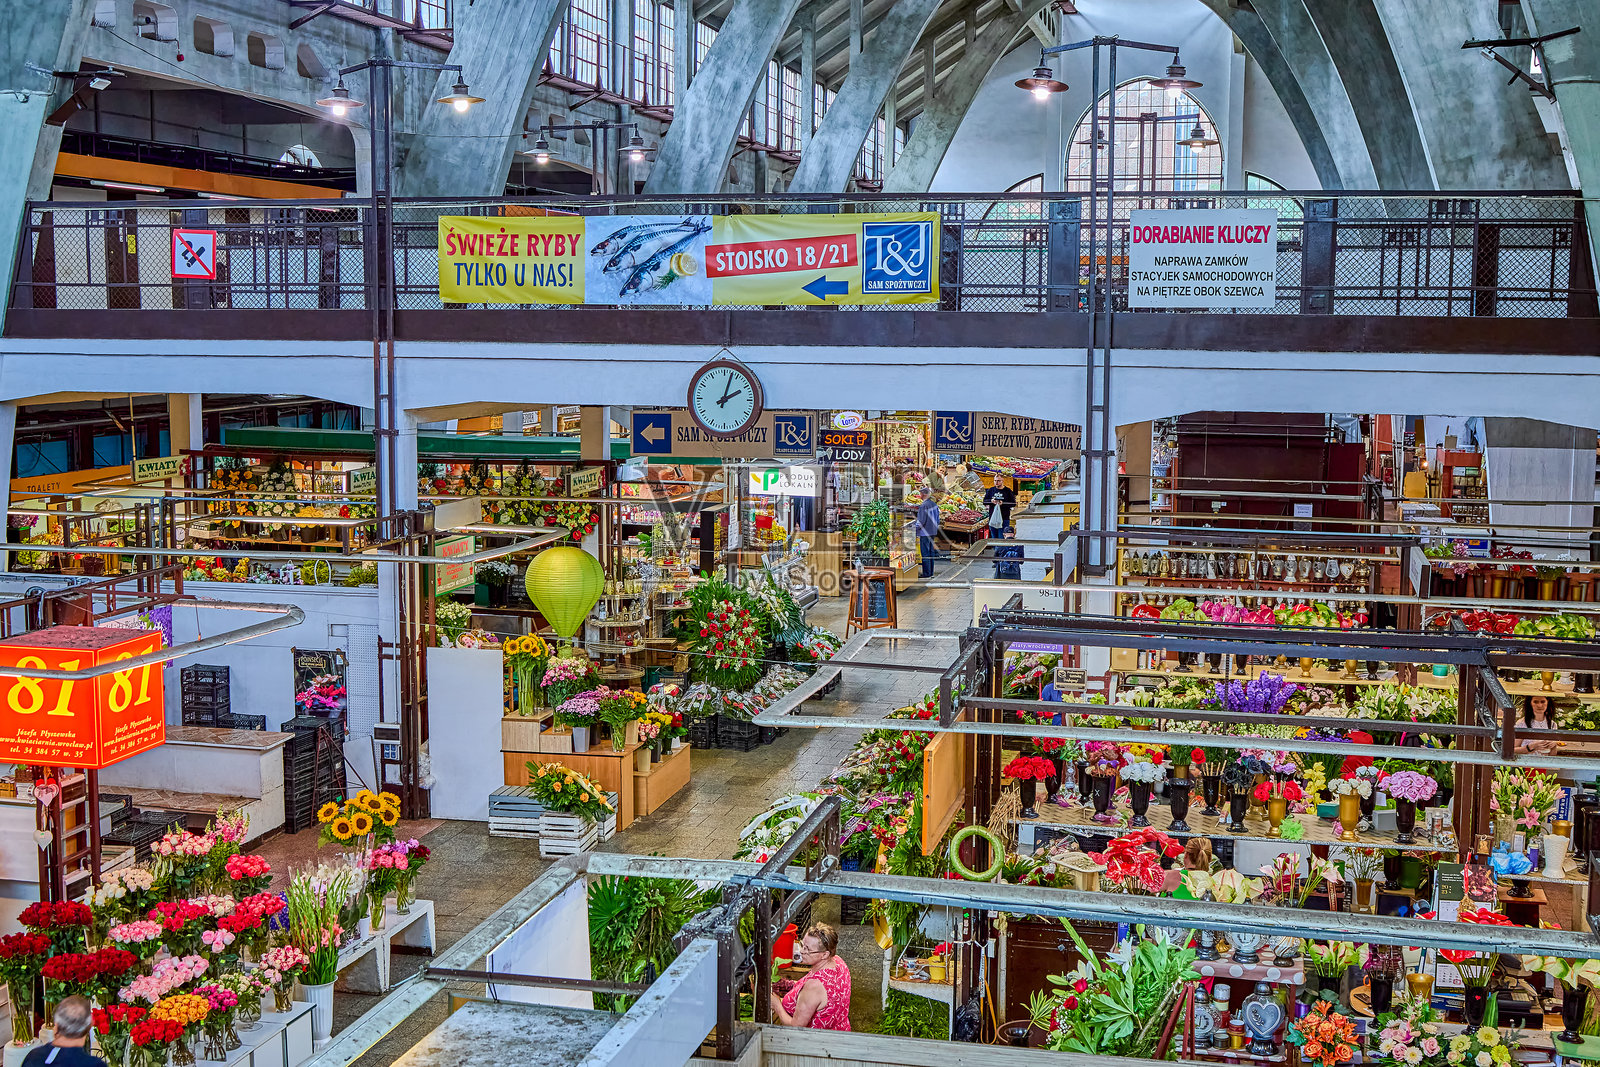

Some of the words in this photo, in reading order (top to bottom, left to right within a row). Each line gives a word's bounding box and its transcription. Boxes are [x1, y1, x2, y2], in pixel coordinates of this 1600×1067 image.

[446, 227, 519, 257] ŚWIEŻE
[527, 234, 581, 257] RYBY
[1133, 225, 1214, 244] DORABIANIE
[1218, 225, 1271, 244] KLUCZY
[866, 222, 926, 276] T&J
[716, 247, 789, 272] STOISKO
[796, 243, 848, 269] 18/21
[1154, 256, 1202, 266] NAPRAWA
[1204, 253, 1249, 267] ZAMKÓW
[454, 262, 507, 287] TYLKO
[514, 263, 525, 286] U
[533, 263, 573, 287] NAS!
[1131, 271, 1180, 282] STACYJEK
[1182, 271, 1274, 282] SAMOCHODOWYCH
[868, 280, 883, 289] SAM
[884, 278, 926, 289] SPOŻYWCZY
[1137, 286, 1150, 297] NA
[1152, 286, 1191, 299] PIĘTRZE
[1193, 286, 1221, 297] OBOK
[1223, 286, 1264, 297] SZEWCA
[775, 416, 812, 446] T&J
[936, 411, 973, 443] T&J
[982, 416, 1008, 431] SERY,
[1011, 417, 1037, 433] RYBY,
[677, 427, 700, 442] SAM
[825, 434, 854, 445] SOKI
[982, 434, 1031, 450] PIECZYWO,
[1035, 436, 1073, 450] ZDROWA
[1076, 434, 1082, 451] Ż
[835, 449, 866, 460] LODY
[138, 460, 177, 473] KWIATY
[353, 471, 376, 483] KWIA
[573, 472, 598, 486] KWIATY
[27, 482, 61, 493] TOALETY
[442, 540, 469, 557] KWIATY
[7, 655, 80, 717] 81
[108, 644, 153, 713] 81
[16, 728, 37, 737] Józefa
